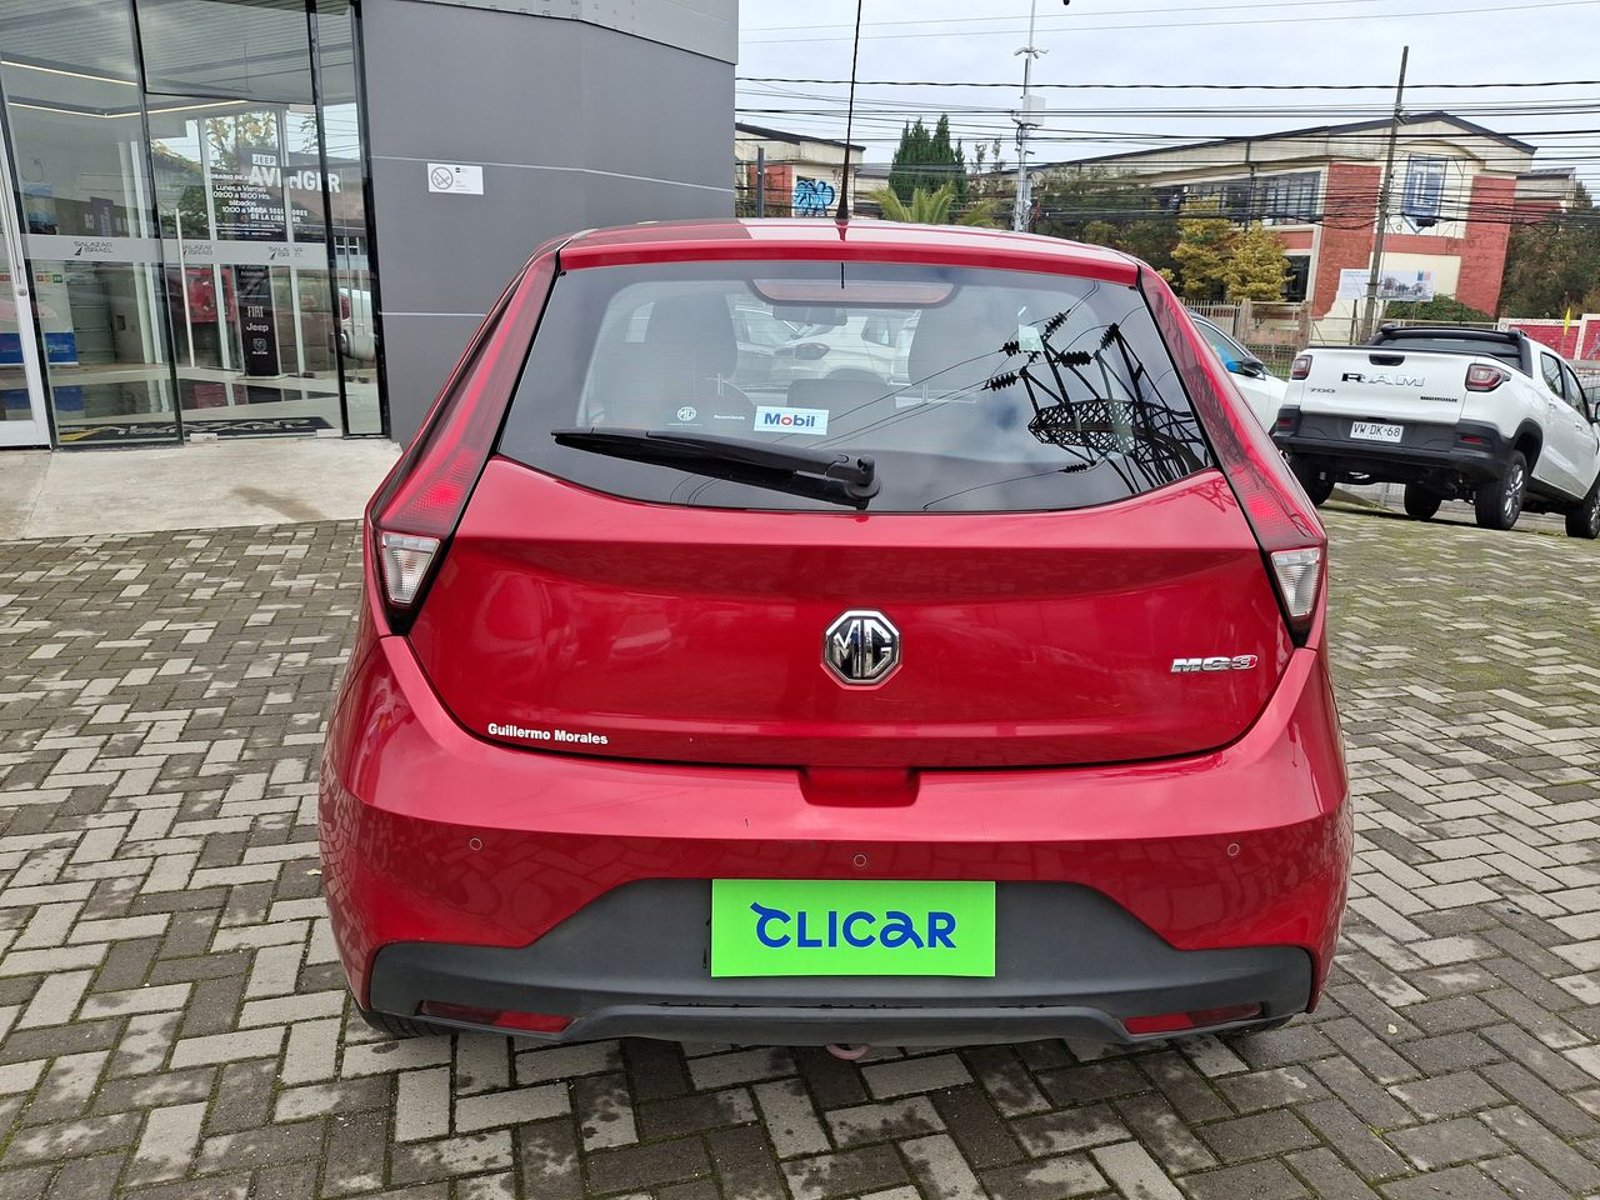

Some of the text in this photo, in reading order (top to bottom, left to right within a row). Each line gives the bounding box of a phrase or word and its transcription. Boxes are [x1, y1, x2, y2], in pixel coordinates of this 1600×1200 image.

[253, 156, 275, 166] JEEP
[249, 166, 341, 193] AVNGR
[247, 306, 264, 318] FIAT
[246, 322, 269, 332] Jeep
[1341, 372, 1426, 387] RAM
[764, 413, 815, 427] Mobil
[1170, 654, 1259, 674] MG3
[488, 723, 608, 745] Guillermo Morales
